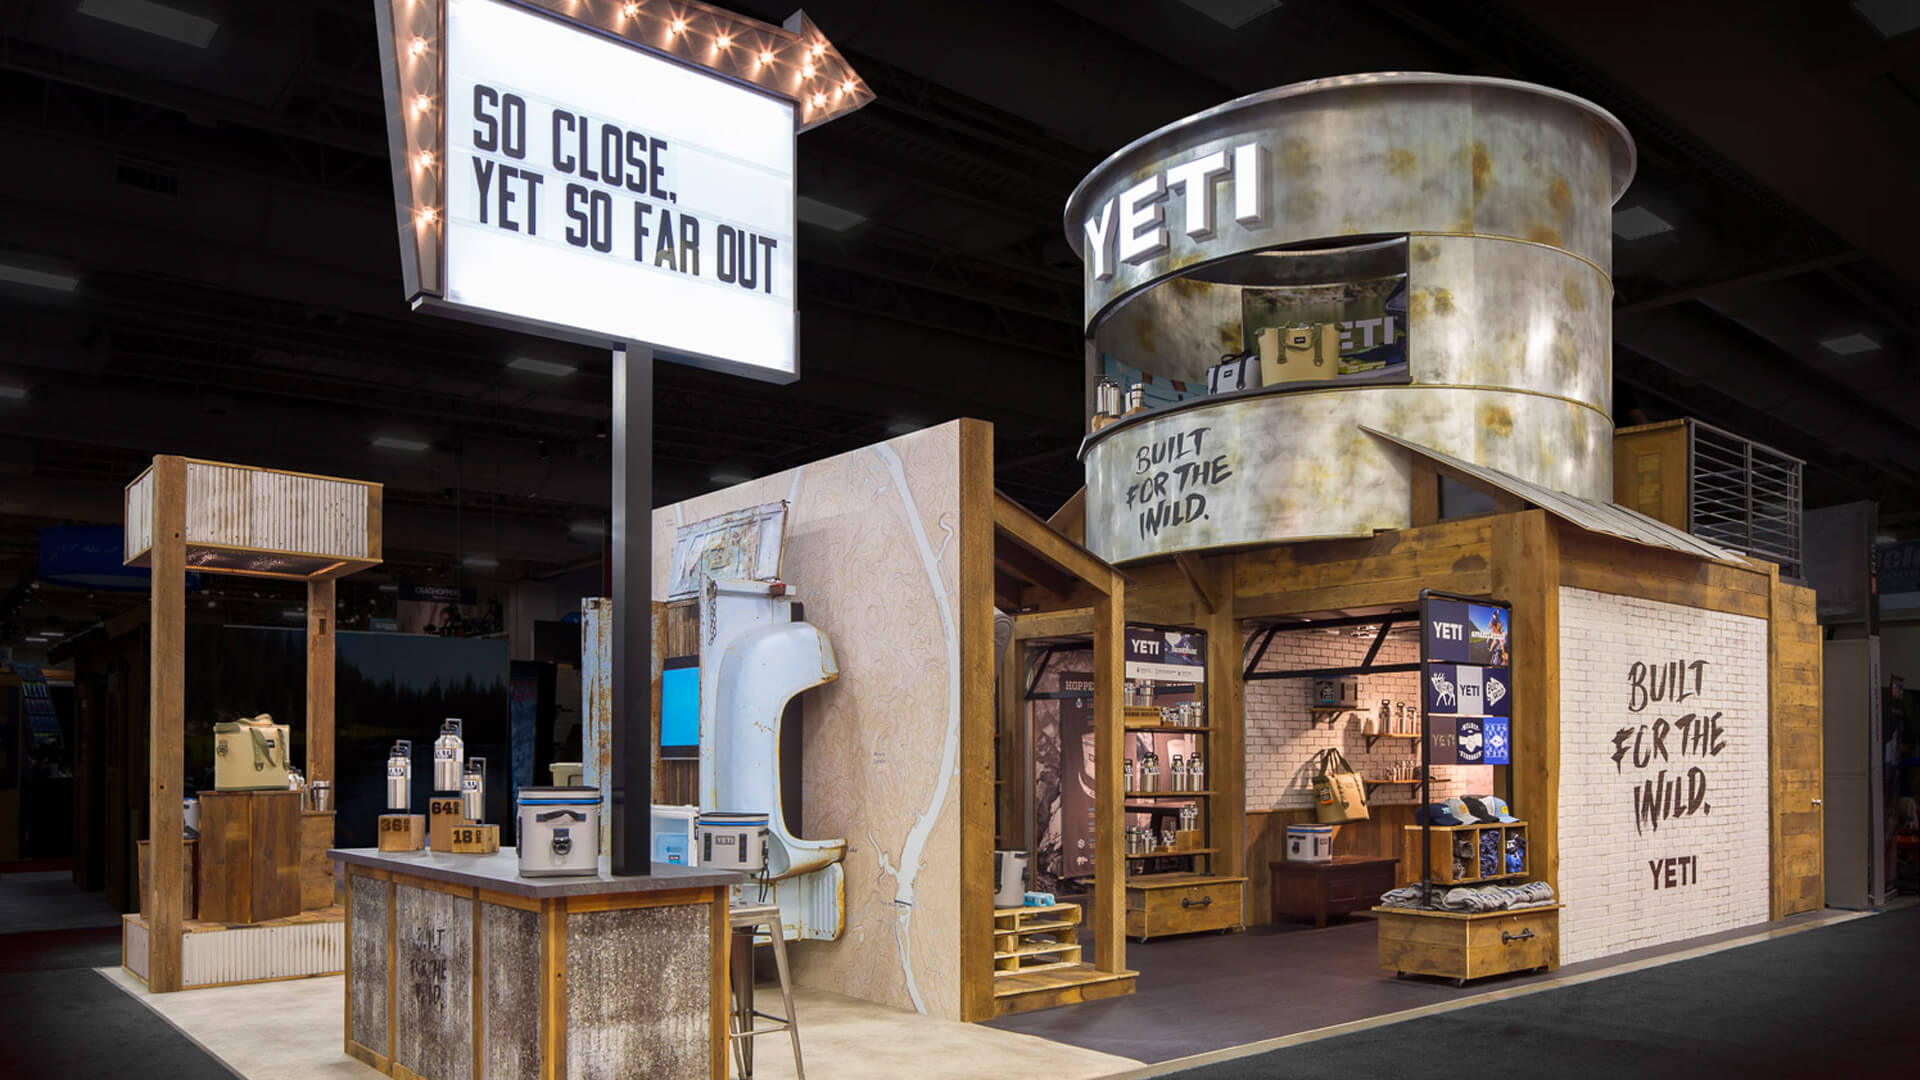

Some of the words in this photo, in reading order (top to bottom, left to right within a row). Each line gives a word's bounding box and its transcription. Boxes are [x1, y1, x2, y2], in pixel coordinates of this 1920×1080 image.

[473, 84, 526, 160] SO
[553, 109, 677, 204] CLOSE,
[472, 156, 544, 235] YET
[565, 183, 612, 253] SO
[634, 201, 700, 276] FAR
[717, 224, 777, 294] OUT
[1084, 142, 1262, 281] YETI
[1340, 316, 1394, 350] ETI
[1136, 427, 1211, 475] BUILT
[1126, 471, 1169, 512] FOR
[1173, 455, 1232, 493] THE
[1139, 493, 1209, 541] WILD.
[1131, 639, 1160, 655] YETI
[1433, 621, 1463, 641] YETI
[1065, 680, 1094, 691] HOPPE
[1460, 684, 1480, 697] YETI
[1628, 659, 1710, 712] BUILT
[1611, 717, 1670, 775] FOR
[1674, 712, 1727, 758] THE
[1634, 766, 1711, 837] WILD.
[453, 830, 473, 844] 18
[1649, 855, 1697, 890] YETI
